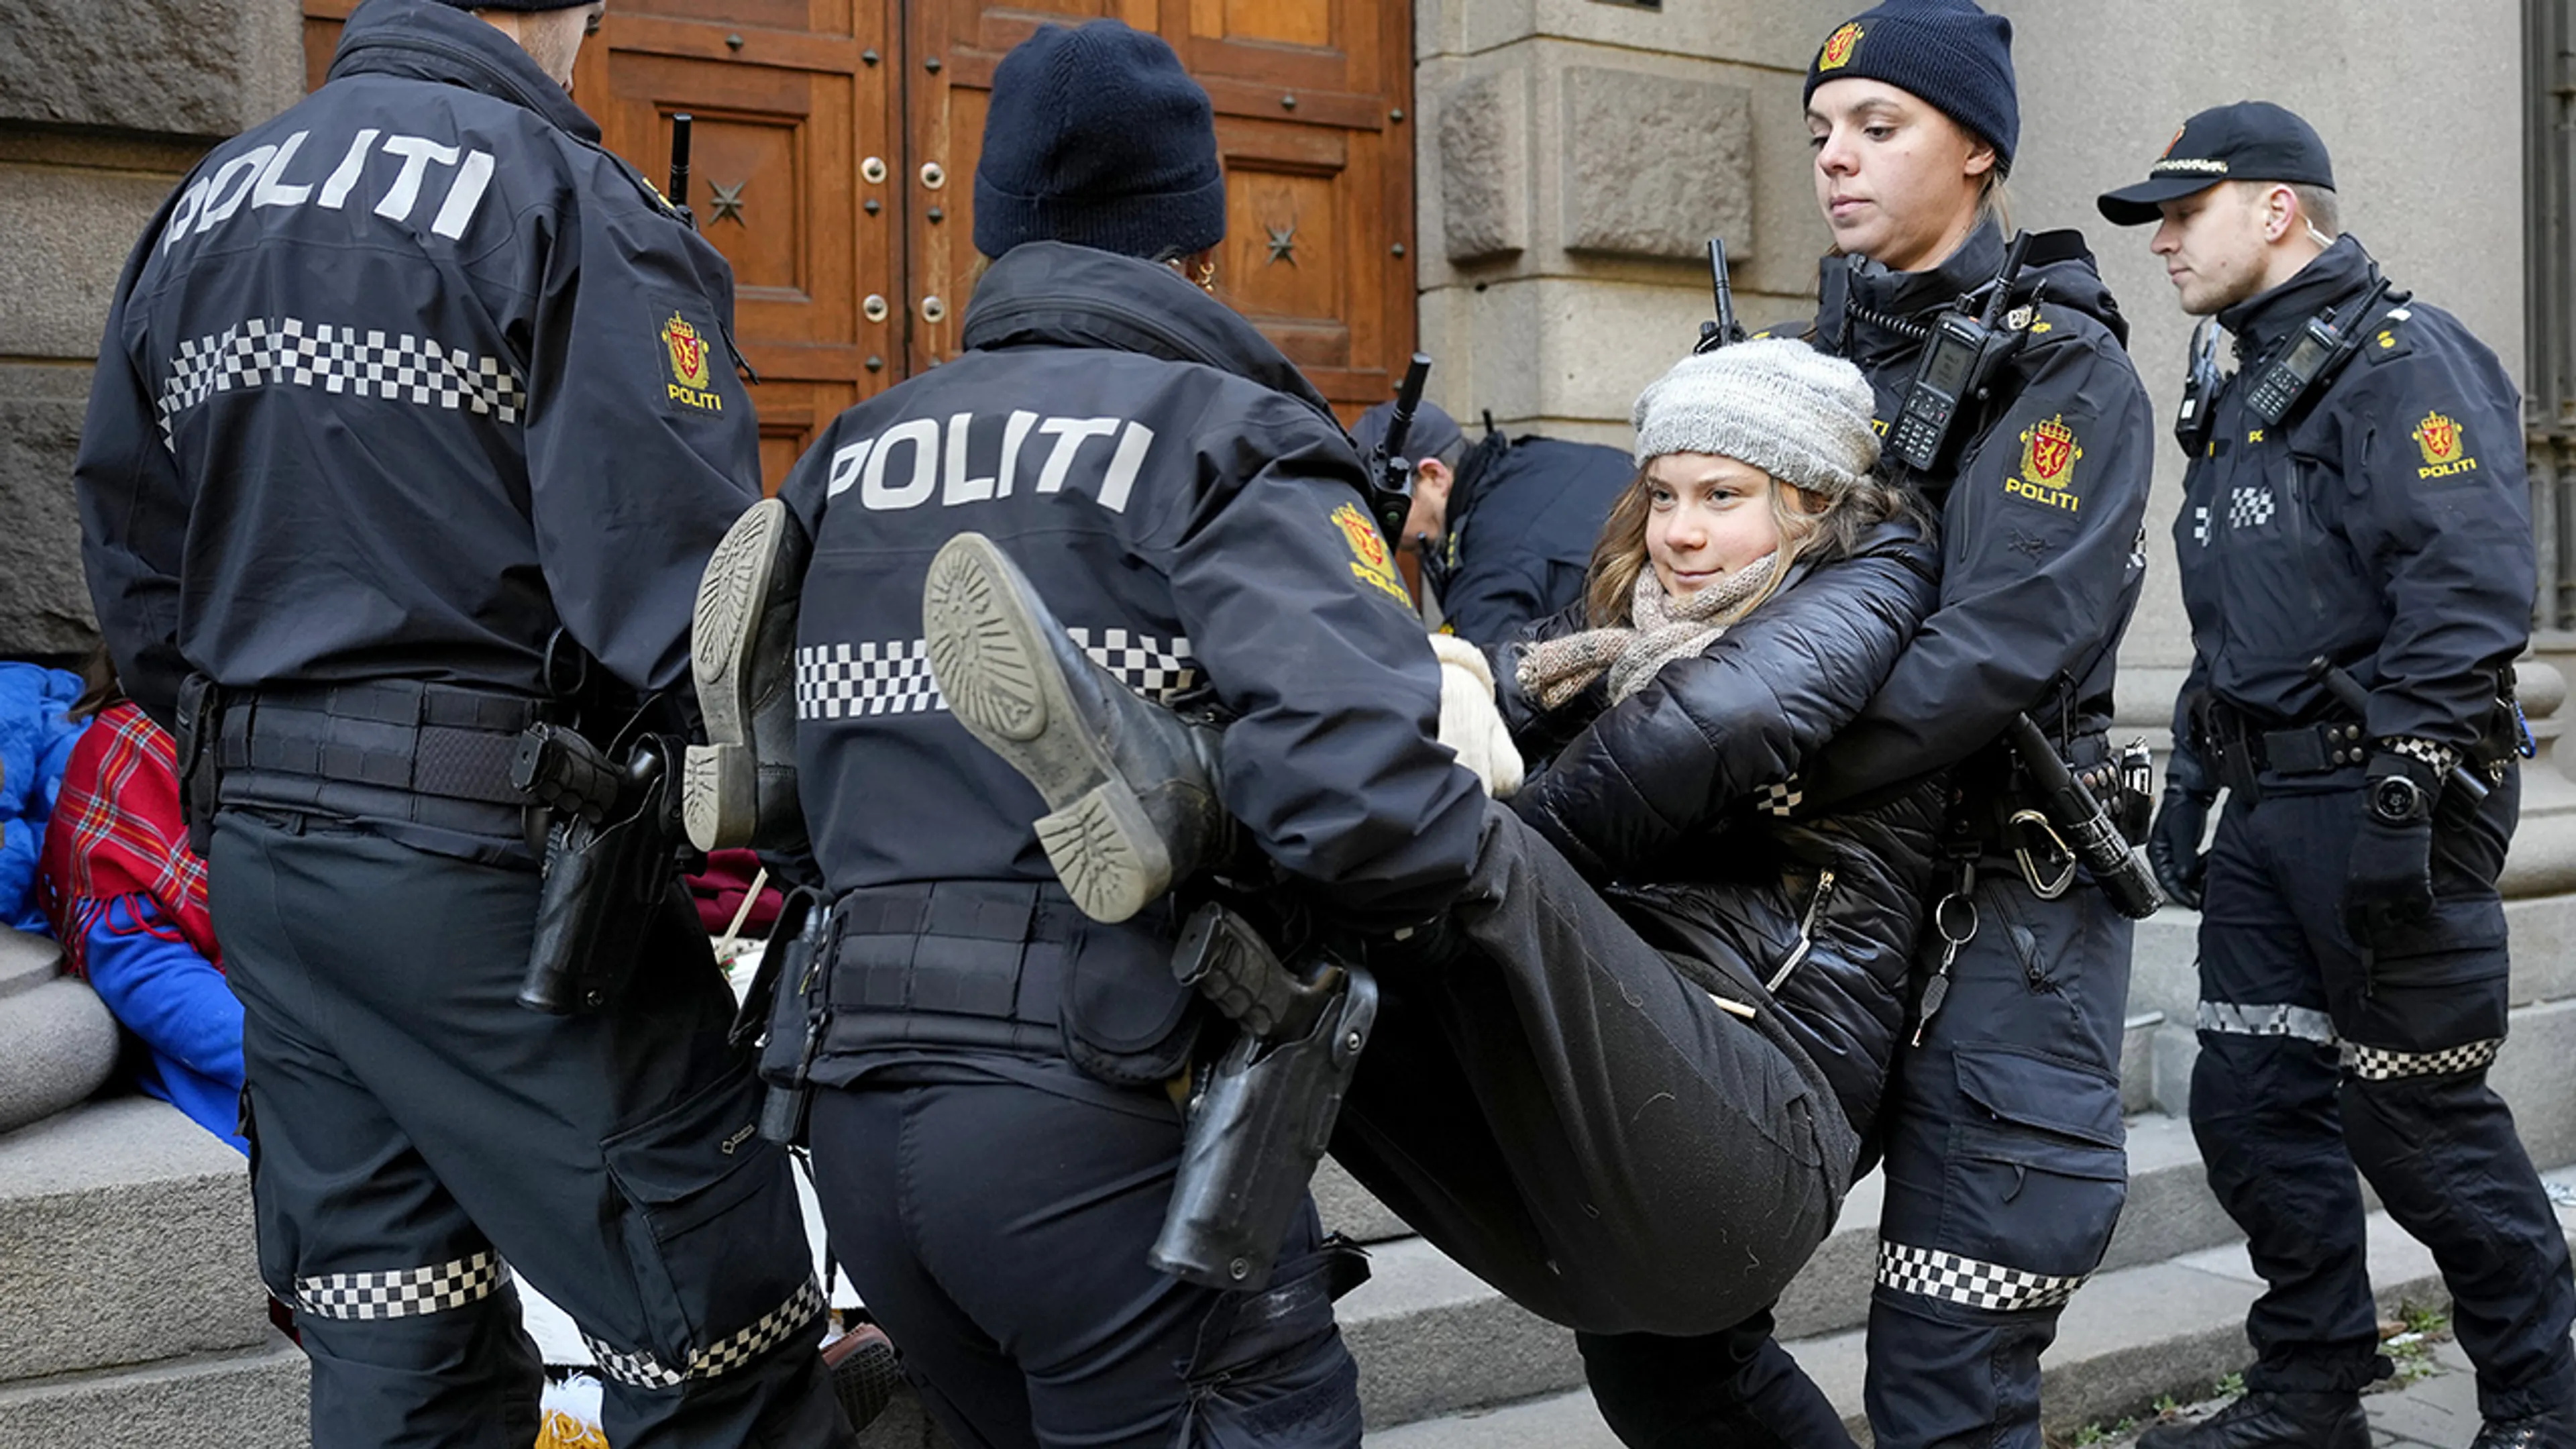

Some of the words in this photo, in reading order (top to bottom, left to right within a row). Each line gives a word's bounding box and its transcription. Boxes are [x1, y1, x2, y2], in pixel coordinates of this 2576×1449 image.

[163, 129, 495, 258] POLITI
[668, 384, 722, 411] POLITI
[828, 410, 1155, 511] POLITI
[2418, 458, 2477, 479] POLITI
[2005, 477, 2078, 512] POLITI
[1348, 561, 1412, 608] POLITI
